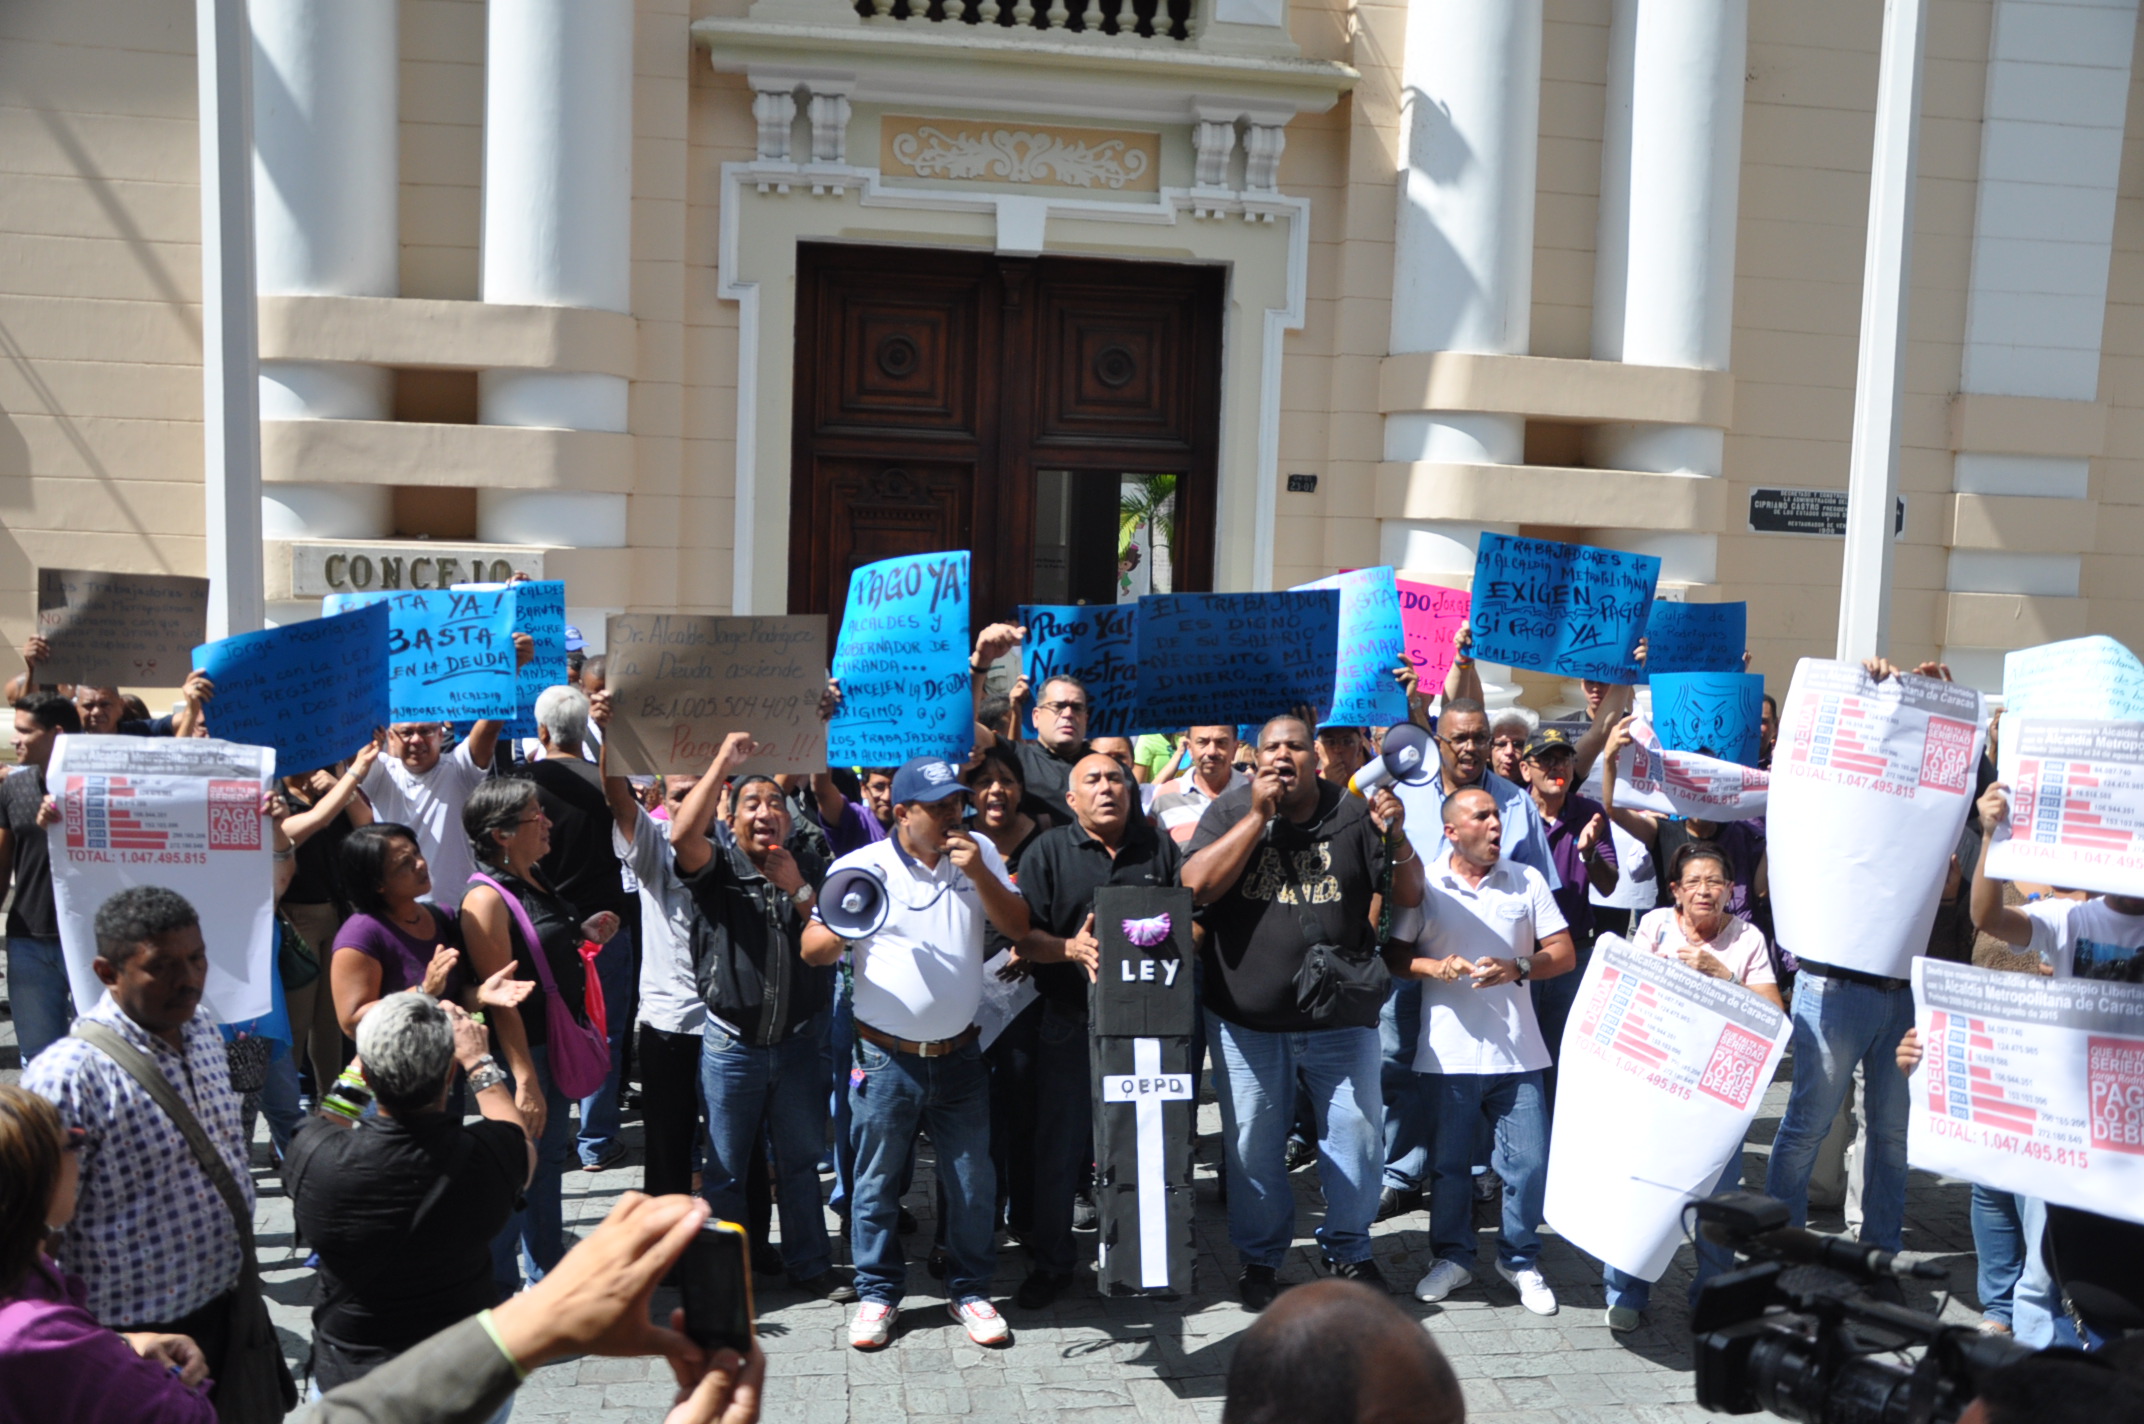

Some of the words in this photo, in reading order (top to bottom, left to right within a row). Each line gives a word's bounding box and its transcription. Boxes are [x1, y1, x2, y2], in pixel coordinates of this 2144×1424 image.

[1755, 500, 1788, 509] CIPRIANO
[1791, 502, 1819, 510] CASTRO
[1494, 536, 1622, 567] TRABAJADORES
[1631, 557, 1648, 575] de
[325, 554, 512, 589] CONCEJO
[854, 562, 922, 612] PAGO
[848, 614, 920, 637] ALCALDES
[1227, 615, 1301, 631] DIGNO
[1509, 617, 1556, 641] PAGO
[1567, 622, 1602, 648] YA
[444, 651, 511, 672] DEUDA
[831, 735, 855, 746] LOS
[1927, 728, 1971, 744] SERIEDAD
[1924, 758, 1939, 770] LO
[1941, 761, 1968, 777] QUE
[1925, 745, 1968, 768] PAGA
[1836, 772, 1915, 799] 1.047.495.815
[1921, 769, 1966, 790] DEBES
[2013, 772, 2036, 827] DEUDA
[67, 790, 81, 835] DEUDA
[211, 808, 255, 823] PAGA
[211, 822, 230, 833] LO
[231, 822, 257, 834] QUE
[211, 833, 259, 845] DEBES
[67, 850, 116, 863] TOTAL:
[120, 852, 207, 865] 1.047.495.815
[1121, 959, 1180, 986] LEY
[1985, 985, 2072, 1009] Metropolitana
[2075, 998, 2093, 1011] de
[2047, 980, 2099, 997] Municipio
[1739, 1002, 1777, 1027] Caracas
[1724, 1028, 1740, 1042] QUE
[1720, 1036, 1765, 1062] SERIEDAD
[2091, 1046, 2113, 1057] QUE
[1712, 1050, 1756, 1083] PAGA
[1928, 1029, 1944, 1096] DEUDA
[1614, 1055, 1693, 1101] 1.047.495.815
[1701, 1074, 1750, 1105] DEBES
[1708, 1064, 1725, 1080] LO
[1725, 1070, 1752, 1090] QUE
[2092, 1081, 2144, 1109] PAG
[2093, 1102, 2119, 1123] LO
[1929, 1116, 1978, 1144] TOTAL:
[1982, 1130, 2089, 1170] 1.047.495.815
